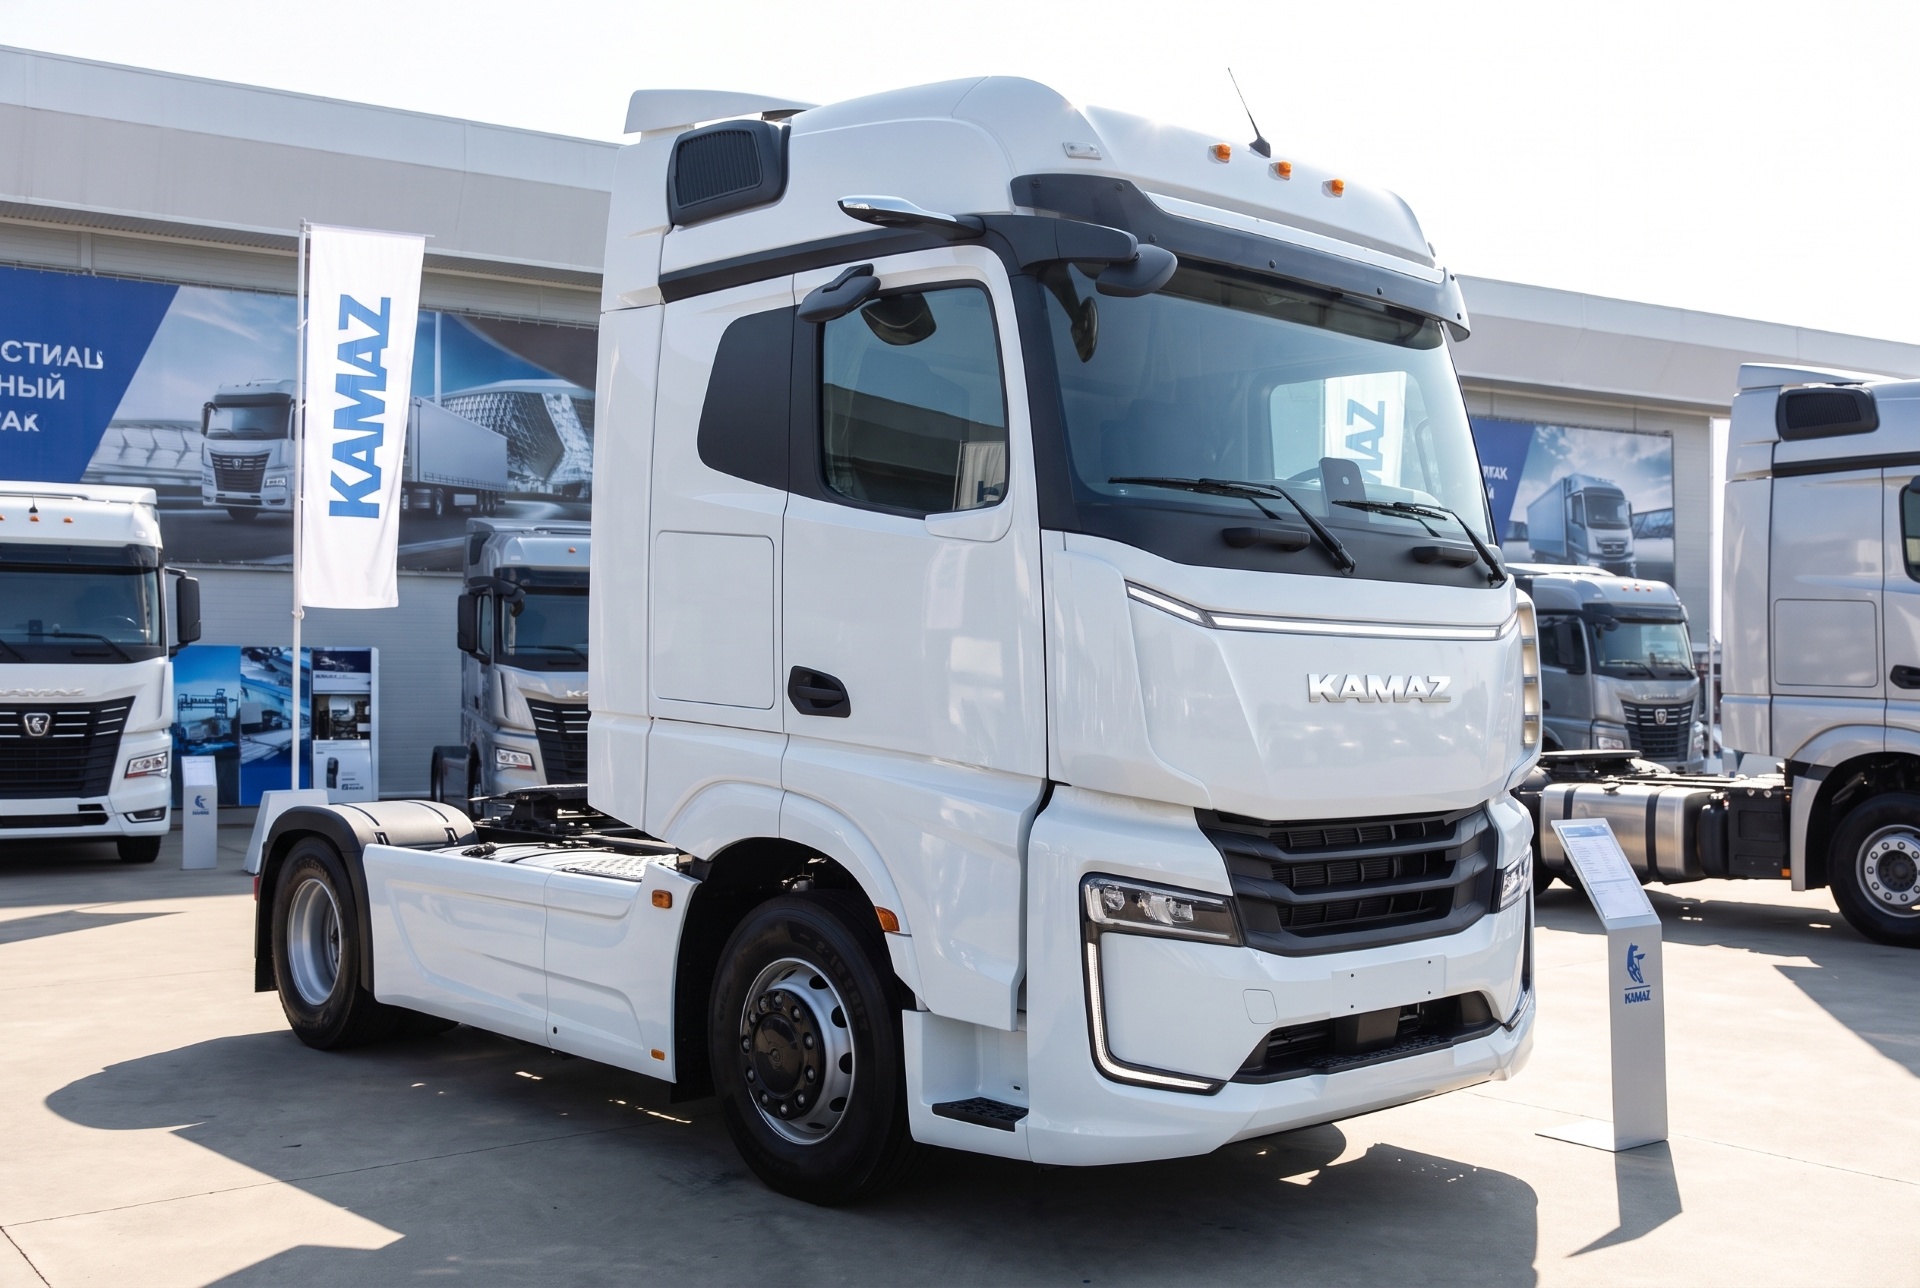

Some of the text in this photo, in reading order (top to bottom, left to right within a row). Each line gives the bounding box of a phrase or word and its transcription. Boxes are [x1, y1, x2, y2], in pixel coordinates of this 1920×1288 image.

[329, 294, 391, 519] KAMAZ
[0, 410, 40, 432] АК
[1307, 674, 1451, 703] KAMAZ
[1624, 989, 1651, 1004] KAMAZ
